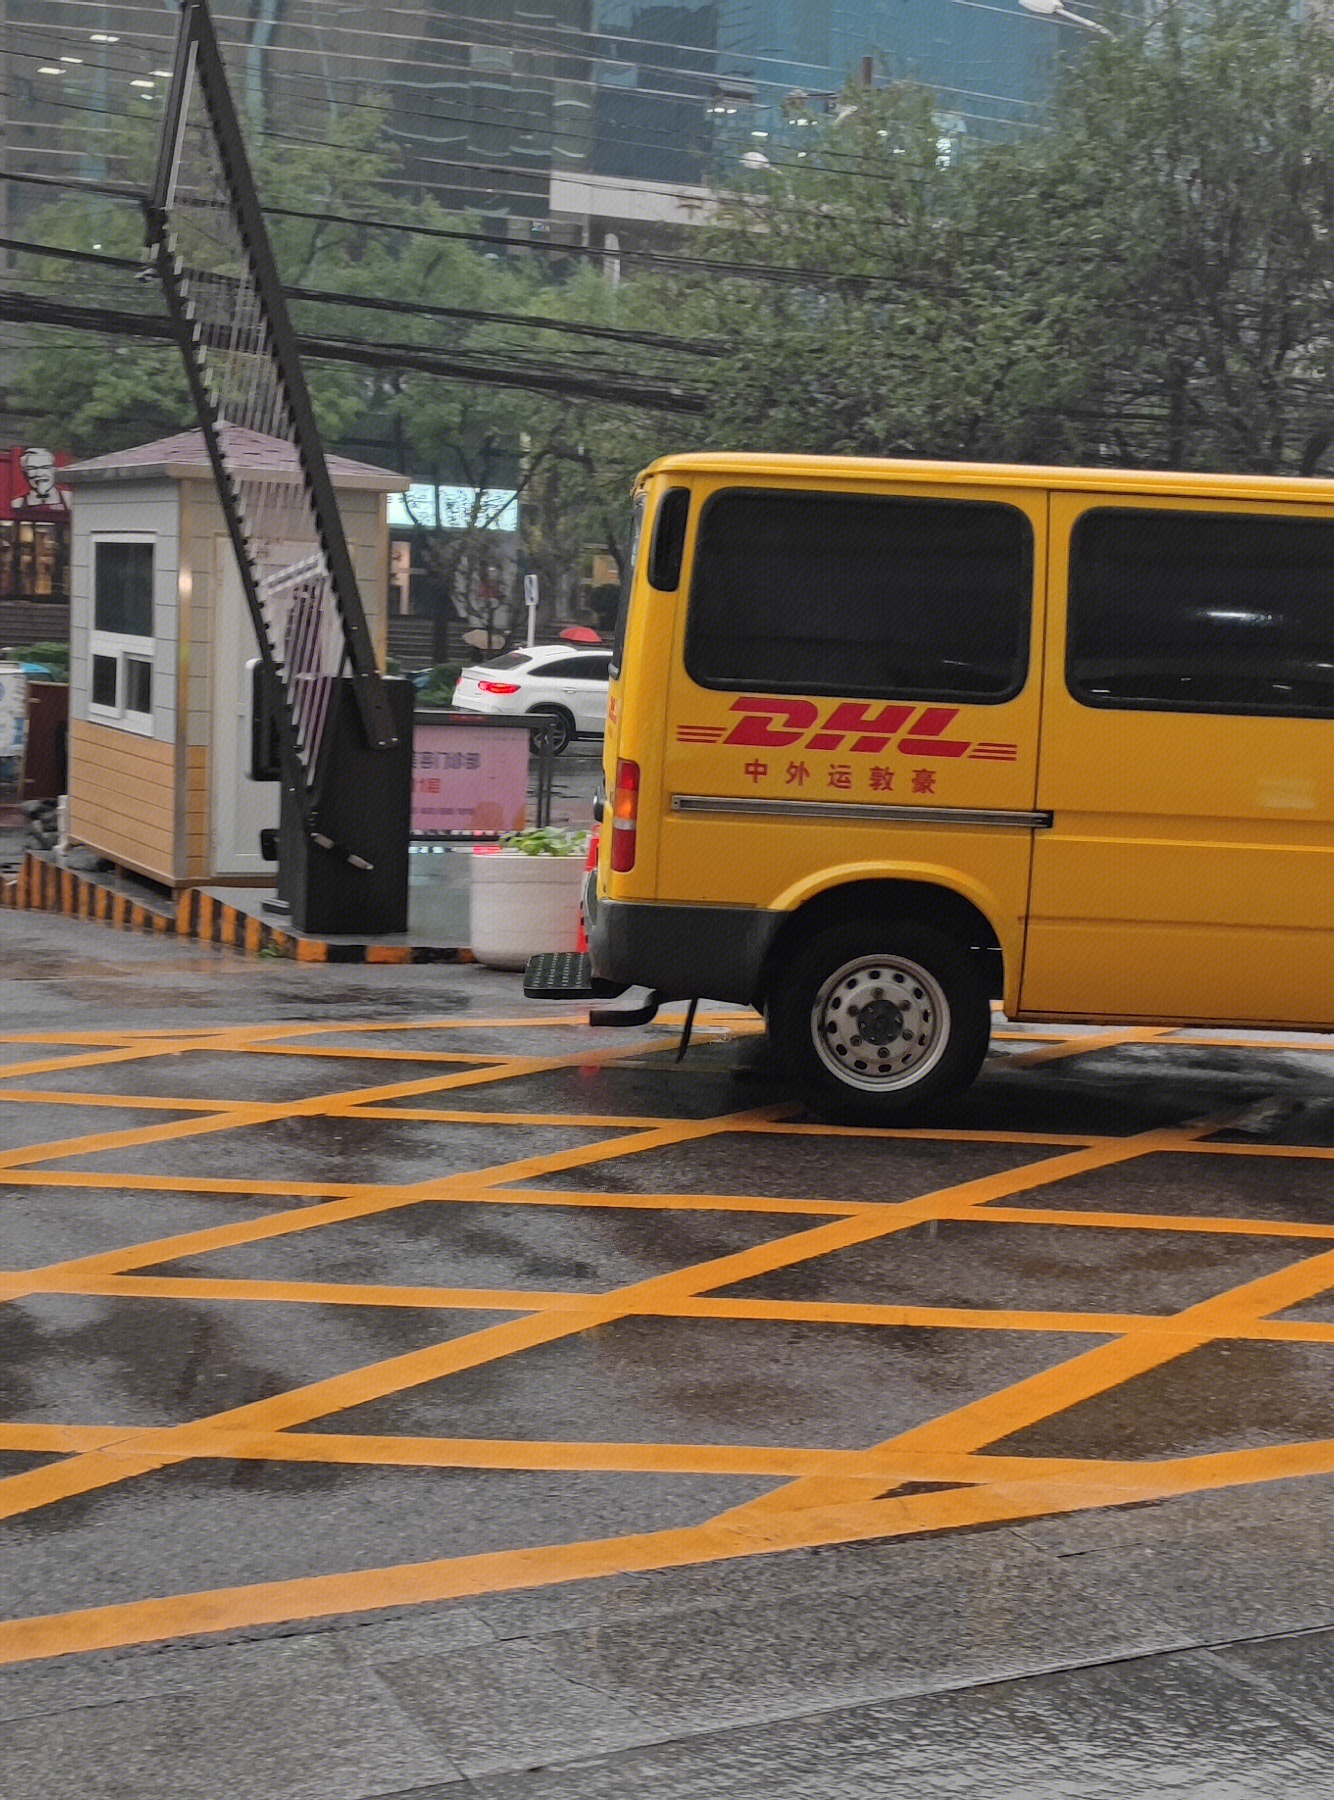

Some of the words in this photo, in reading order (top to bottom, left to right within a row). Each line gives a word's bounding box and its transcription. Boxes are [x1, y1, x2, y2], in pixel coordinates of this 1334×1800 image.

[723, 696, 973, 758] DHL
[744, 757, 937, 794] 中外运敦豪
